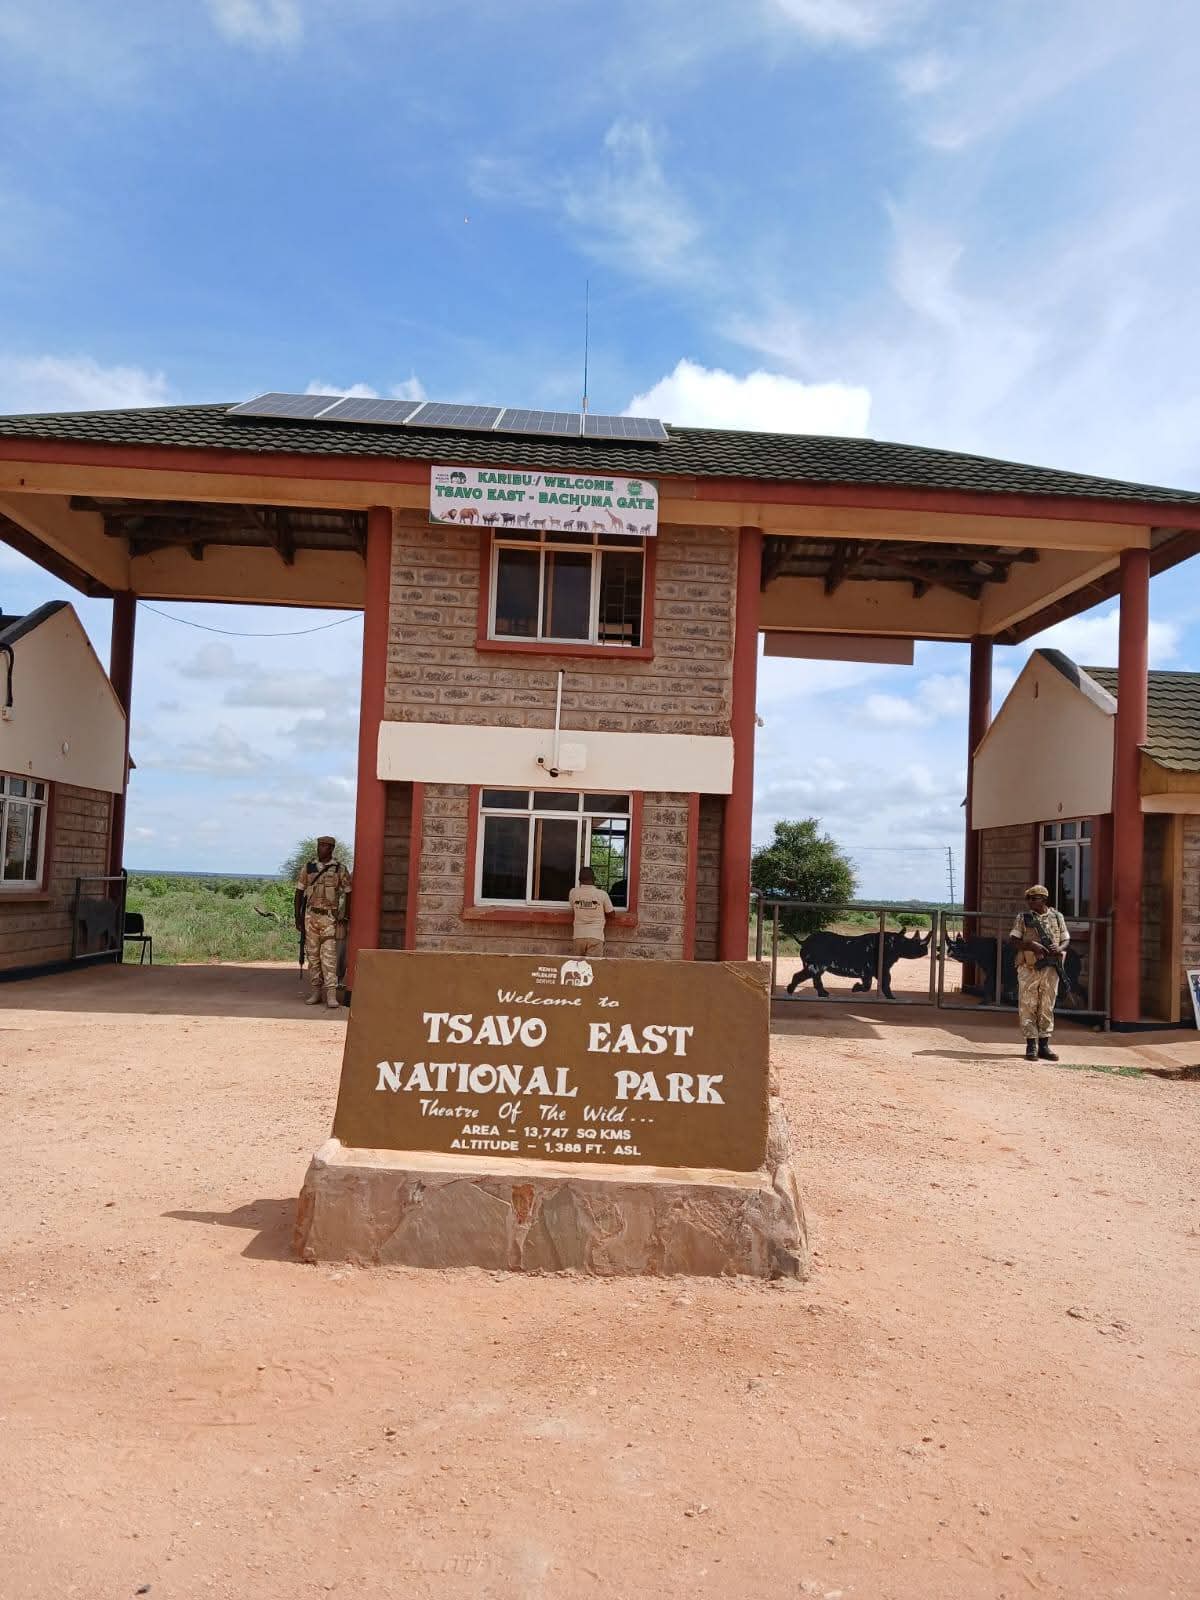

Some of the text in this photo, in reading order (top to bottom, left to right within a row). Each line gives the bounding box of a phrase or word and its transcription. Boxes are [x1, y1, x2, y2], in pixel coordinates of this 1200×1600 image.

[435, 485, 483, 499] TSAVO
[487, 488, 525, 502] EAST
[538, 492, 613, 507] BACHUMA
[617, 497, 655, 510] GATE
[497, 989, 620, 1008] Welcome to
[423, 1012, 694, 1056] TSAVO EAST
[375, 1061, 726, 1104] NATIONAL PARK
[419, 1099, 480, 1118] Theatre
[498, 1101, 523, 1124] Of
[539, 1104, 567, 1121] The
[461, 1125, 500, 1136] AREA
[523, 1127, 569, 1139] 13,747
[576, 1129, 597, 1139] SQ
[600, 1130, 632, 1140] KMS
[450, 1139, 520, 1151] ALTITUDE
[585, 1144, 607, 1155] FT.
[613, 1145, 642, 1156] ASL
